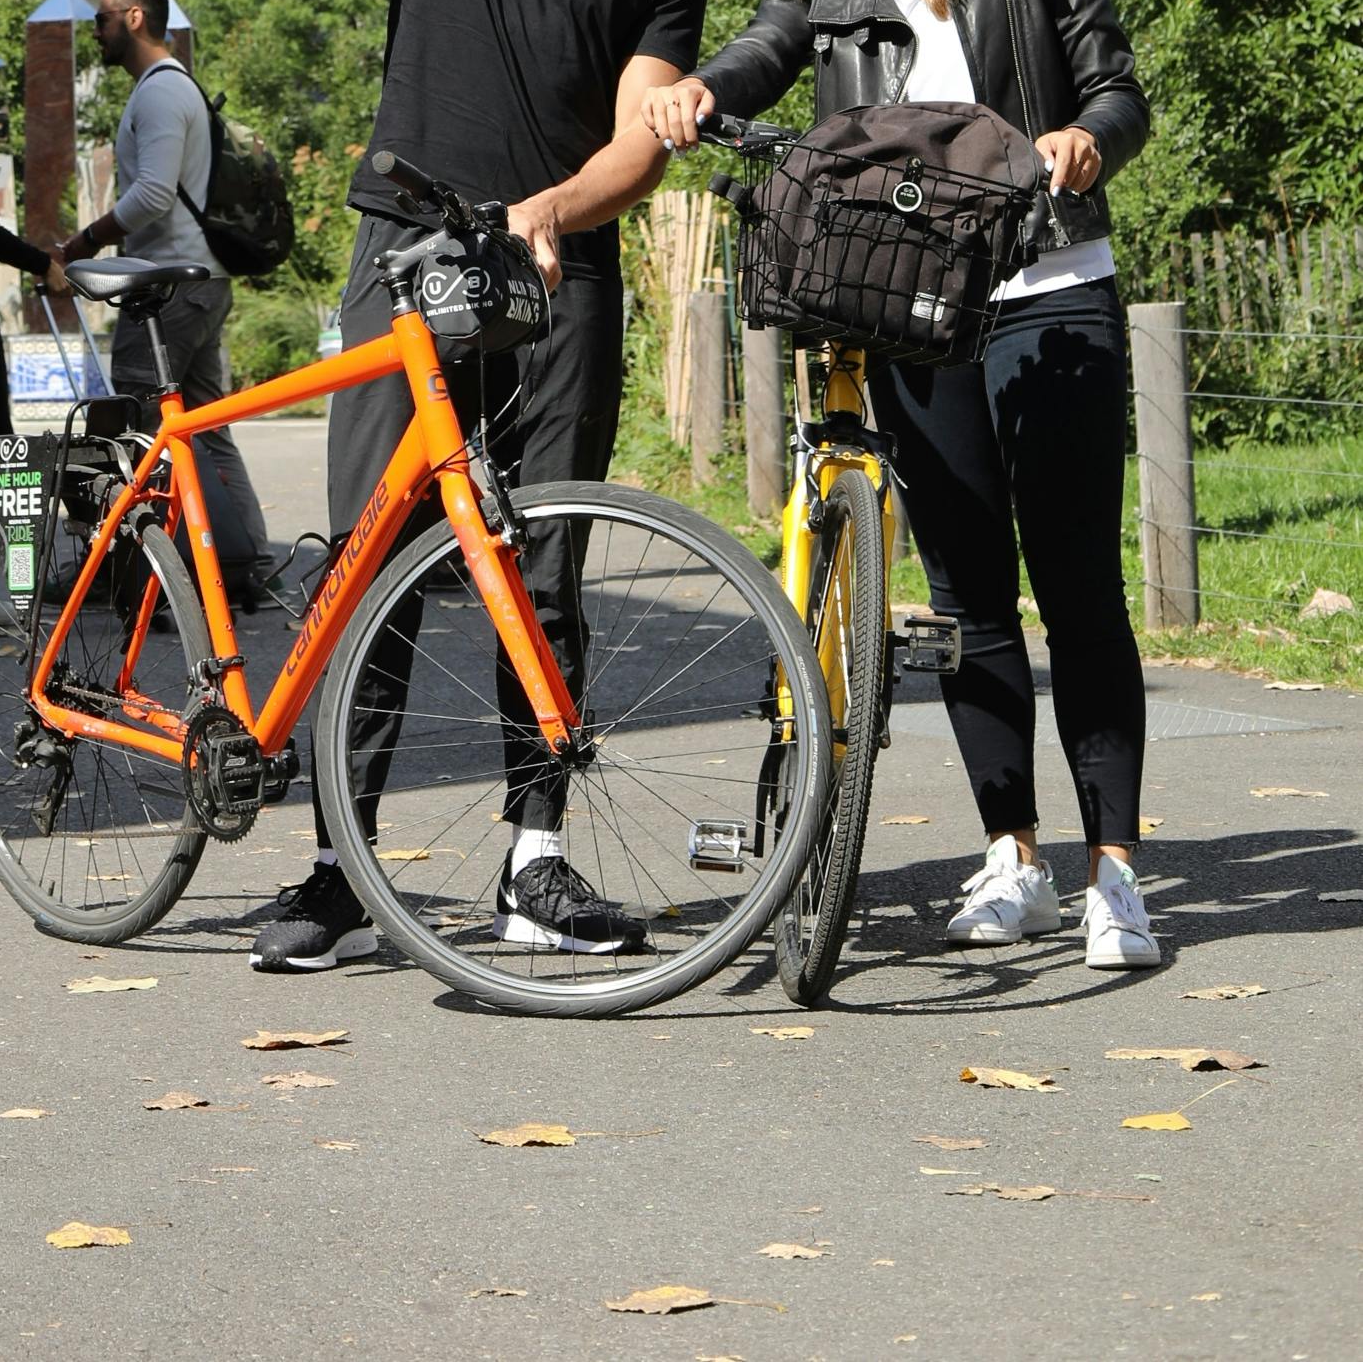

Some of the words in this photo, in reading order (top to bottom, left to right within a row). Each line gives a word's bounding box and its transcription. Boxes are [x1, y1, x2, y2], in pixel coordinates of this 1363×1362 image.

[426, 305, 464, 317] UNLIMITED
[466, 300, 493, 311] BIKNG
[12, 471, 42, 487] HOUR
[5, 524, 35, 542] RIDE
[286, 481, 389, 676] cannondale
